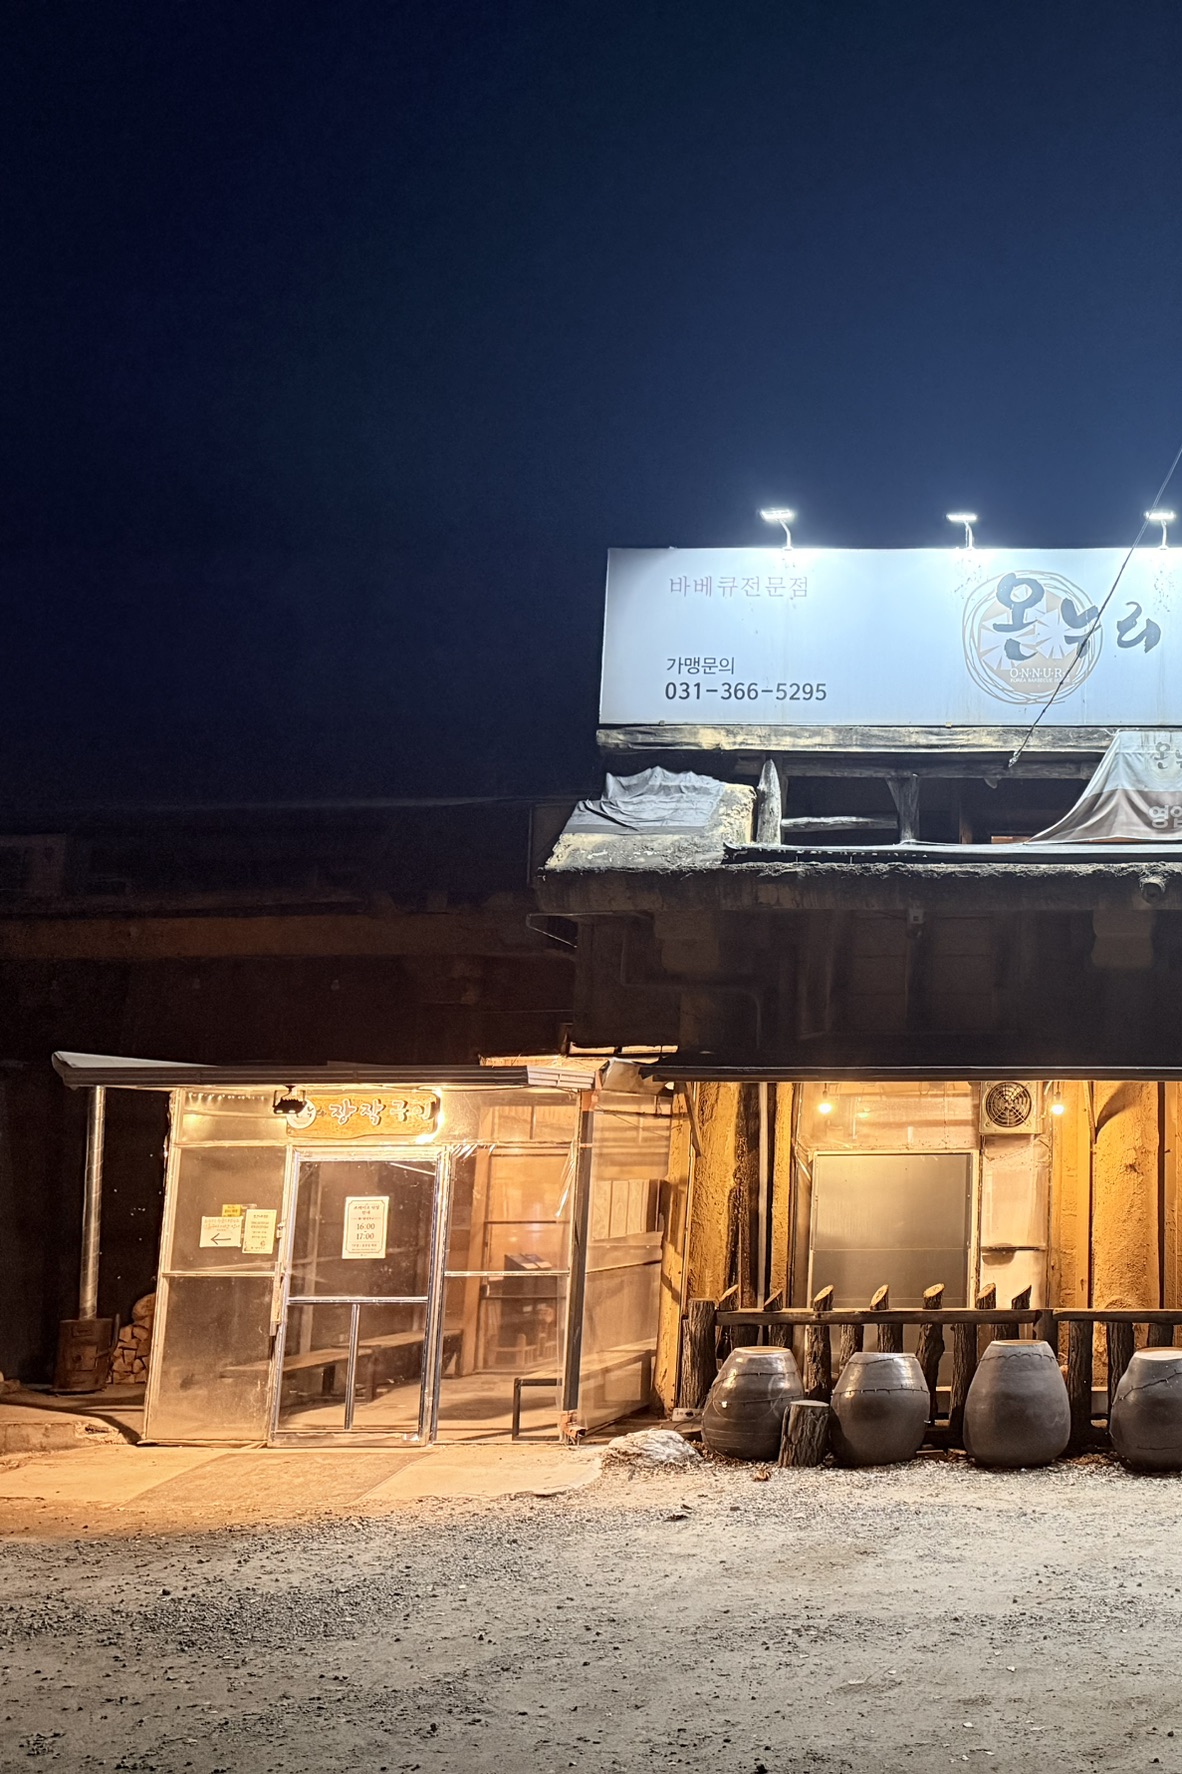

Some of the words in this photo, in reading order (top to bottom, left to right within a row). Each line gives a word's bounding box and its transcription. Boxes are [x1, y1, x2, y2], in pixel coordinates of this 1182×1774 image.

[669, 575, 808, 598] 바베큐전문점
[666, 656, 735, 675] 가맹문의
[665, 681, 828, 701] 031-366-5295
[328, 1098, 434, 1126] 장작구이
[356, 1222, 376, 1230] 16:00
[356, 1232, 375, 1240] 17:00
